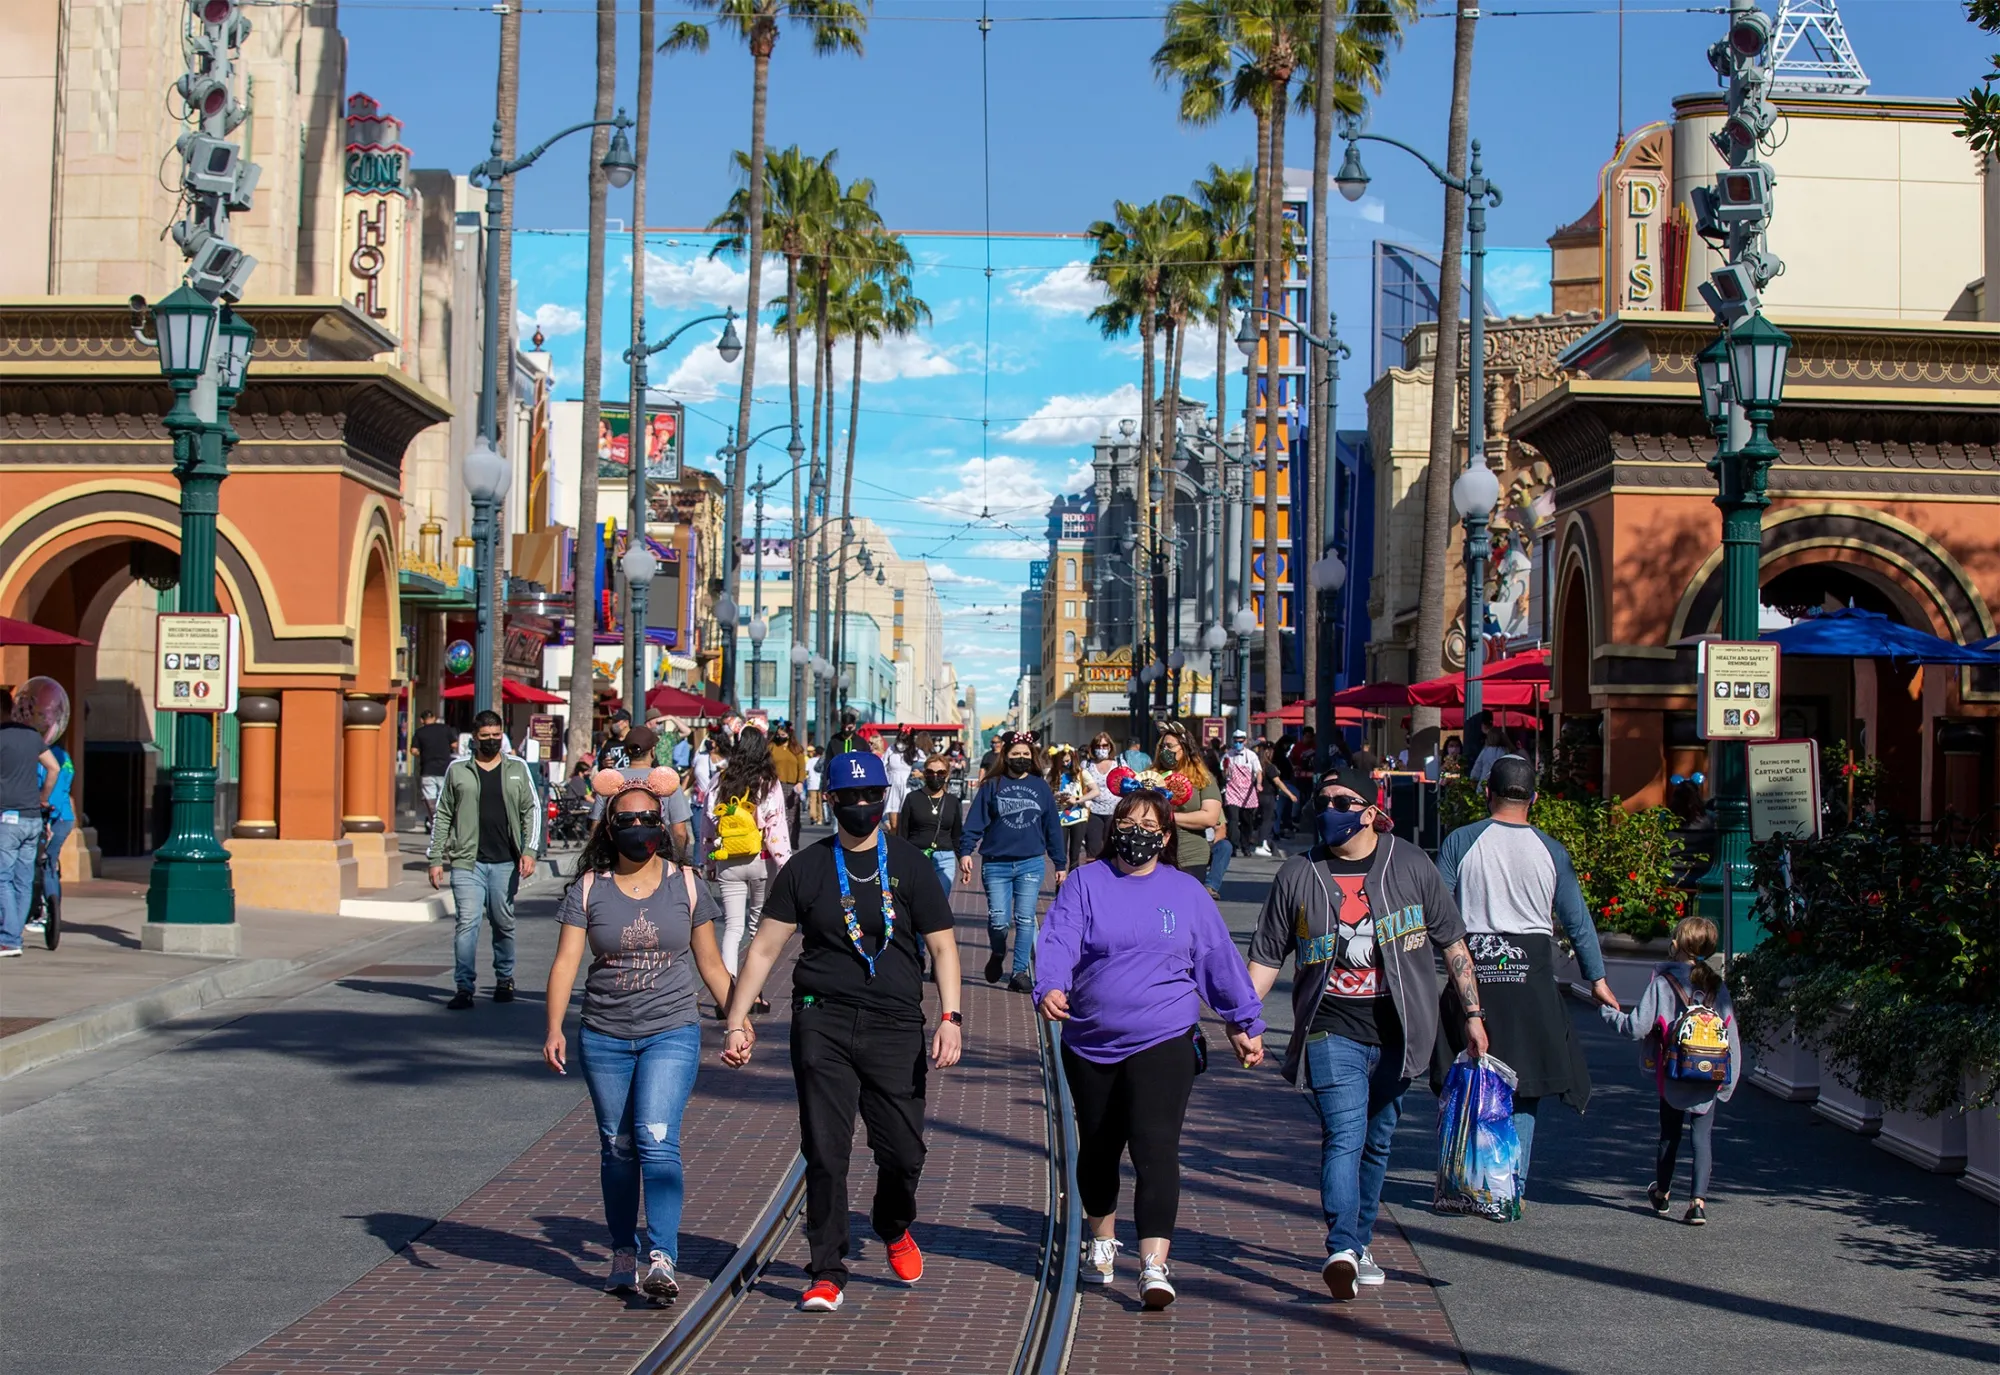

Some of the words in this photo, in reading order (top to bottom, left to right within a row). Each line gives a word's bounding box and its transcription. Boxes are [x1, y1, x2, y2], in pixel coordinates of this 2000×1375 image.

[347, 153, 402, 187] GONE
[1628, 180, 1658, 311] DIS
[850, 759, 866, 779] LA
[1000, 786, 1011, 795] THE
[1011, 785, 1039, 799] ORIGINAL
[1375, 904, 1426, 947] EYLAN
[1403, 931, 1428, 953] 1955
[632, 951, 673, 970] HAPPY
[1503, 962, 1530, 971] LIVING
[615, 970, 660, 991] PLACE
